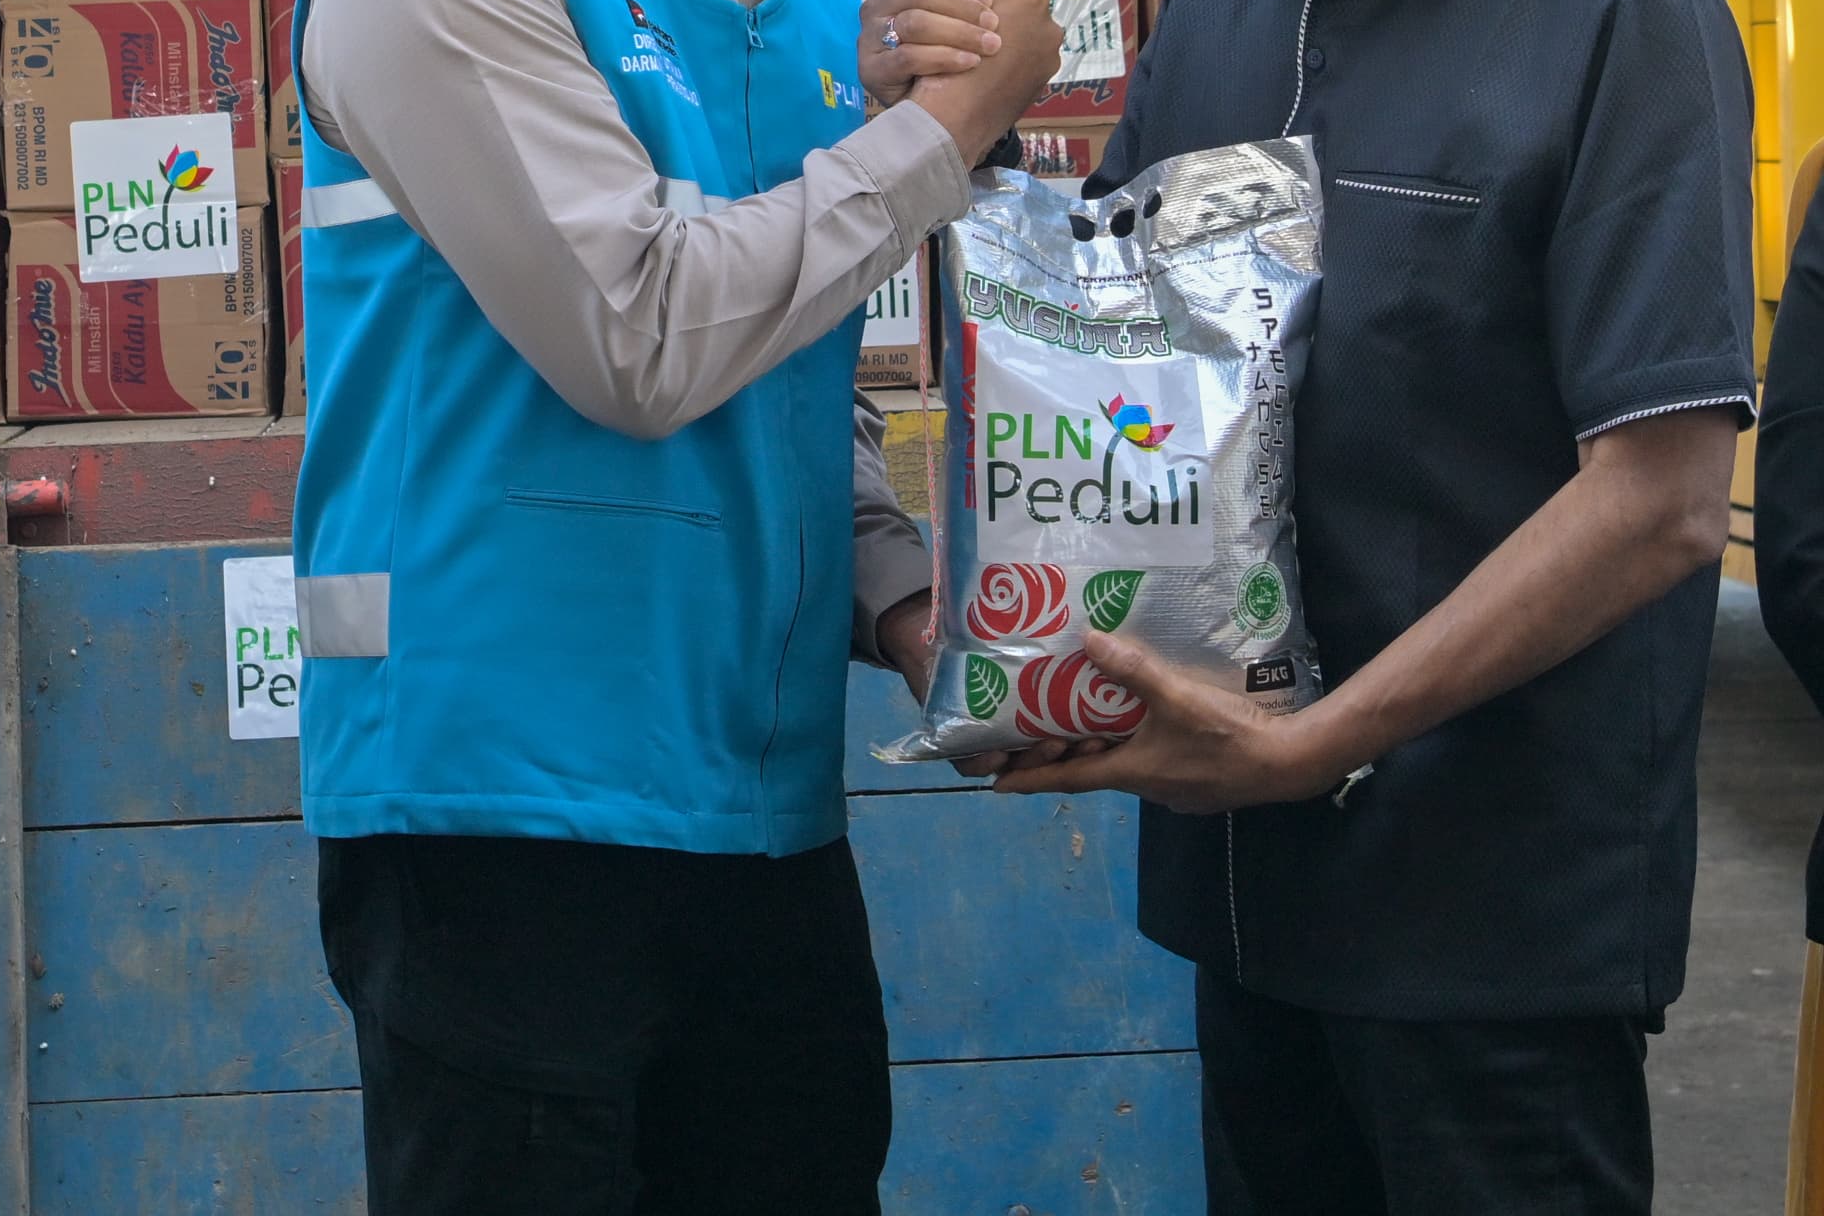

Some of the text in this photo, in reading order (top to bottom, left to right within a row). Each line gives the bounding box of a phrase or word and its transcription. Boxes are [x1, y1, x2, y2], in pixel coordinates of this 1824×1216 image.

[18, 18, 54, 78] 40
[168, 42, 182, 59] Mi
[14, 103, 29, 191] 231509007002
[32, 107, 48, 186] BPOM RI MD
[82, 179, 154, 214] PLN
[84, 205, 229, 256] Peduli
[241, 227, 255, 316] 231509007002
[88, 306, 103, 373] Mi Instan
[123, 279, 153, 385] Kaldu Ay
[248, 340, 257, 371] BKS
[872, 353, 909, 366] RI MD
[215, 340, 250, 400] 40
[986, 412, 1092, 461] PLN
[987, 460, 1200, 526] Peduli
